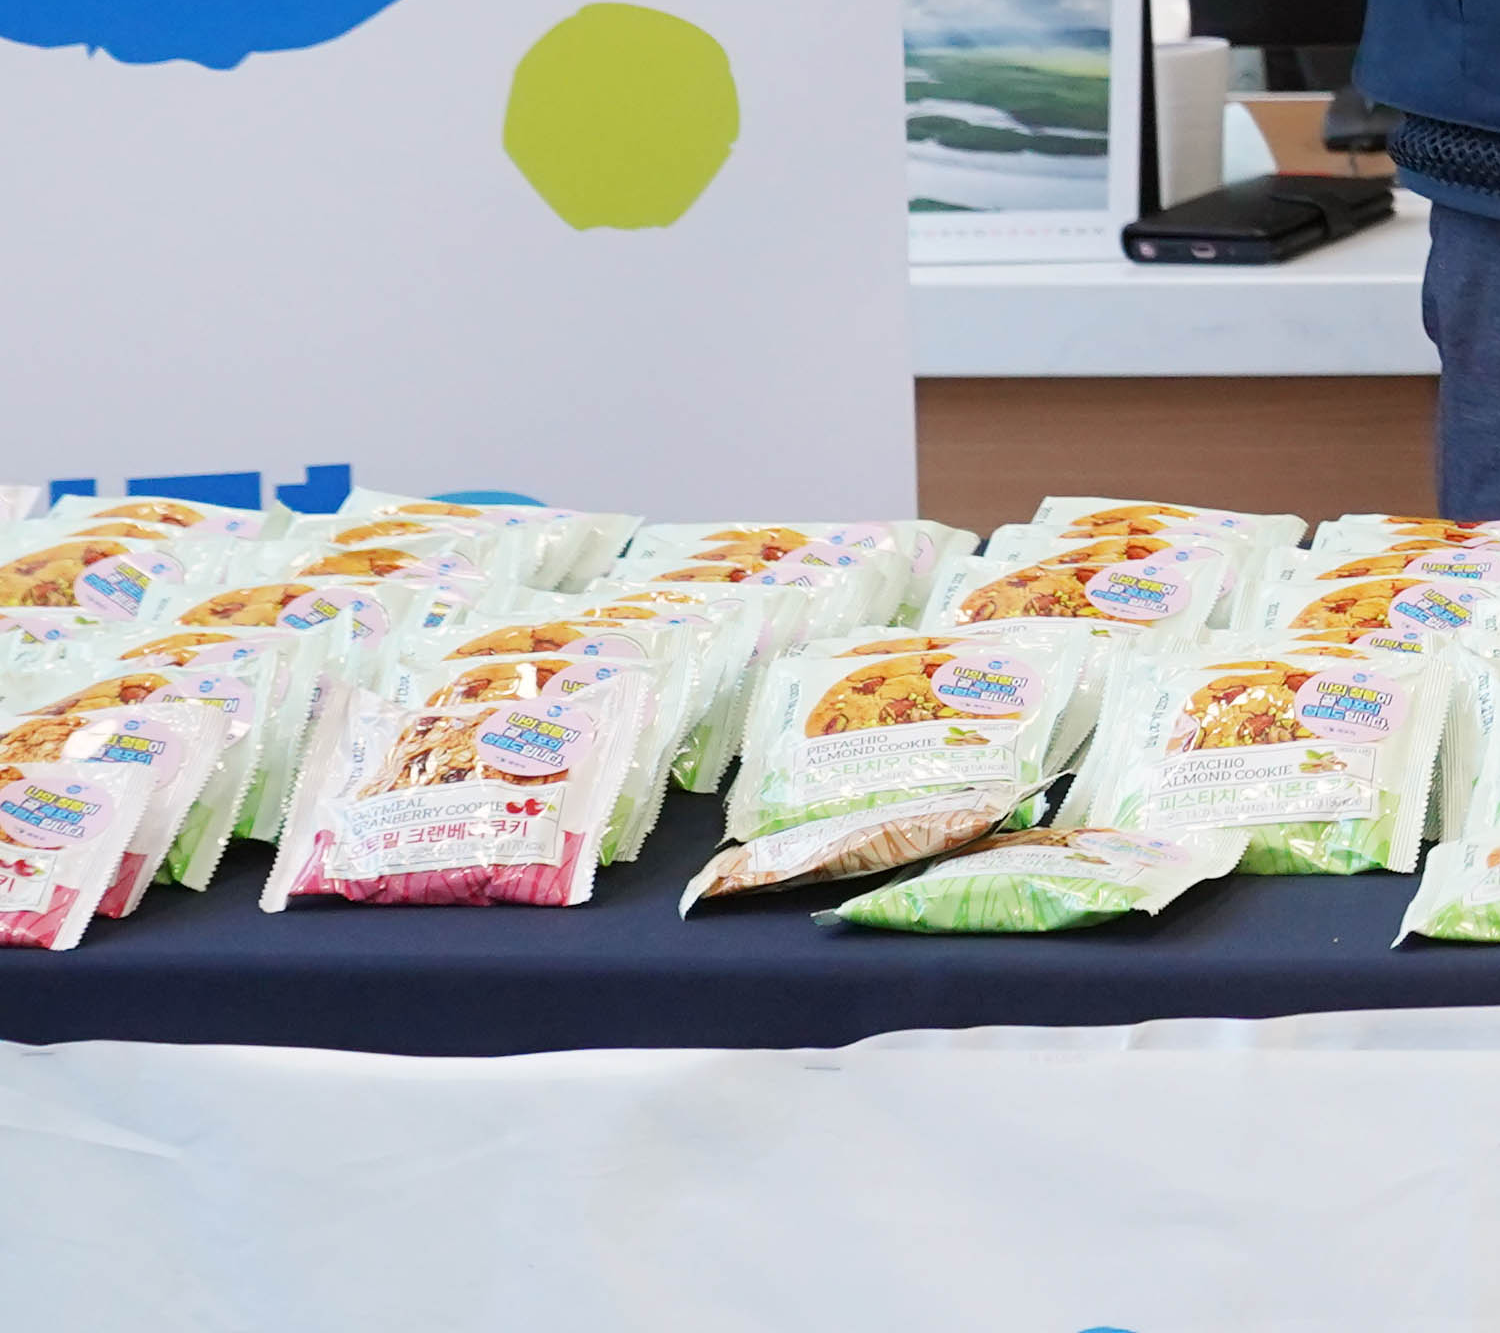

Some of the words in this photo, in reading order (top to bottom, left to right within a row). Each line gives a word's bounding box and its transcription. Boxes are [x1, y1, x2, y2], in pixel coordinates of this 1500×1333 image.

[806, 734, 888, 757] PISTACHIO
[806, 747, 875, 766] ALMOND
[878, 737, 937, 753] COOKIE
[1161, 769, 1232, 790] ALMOND
[1234, 764, 1294, 781] COOKIE
